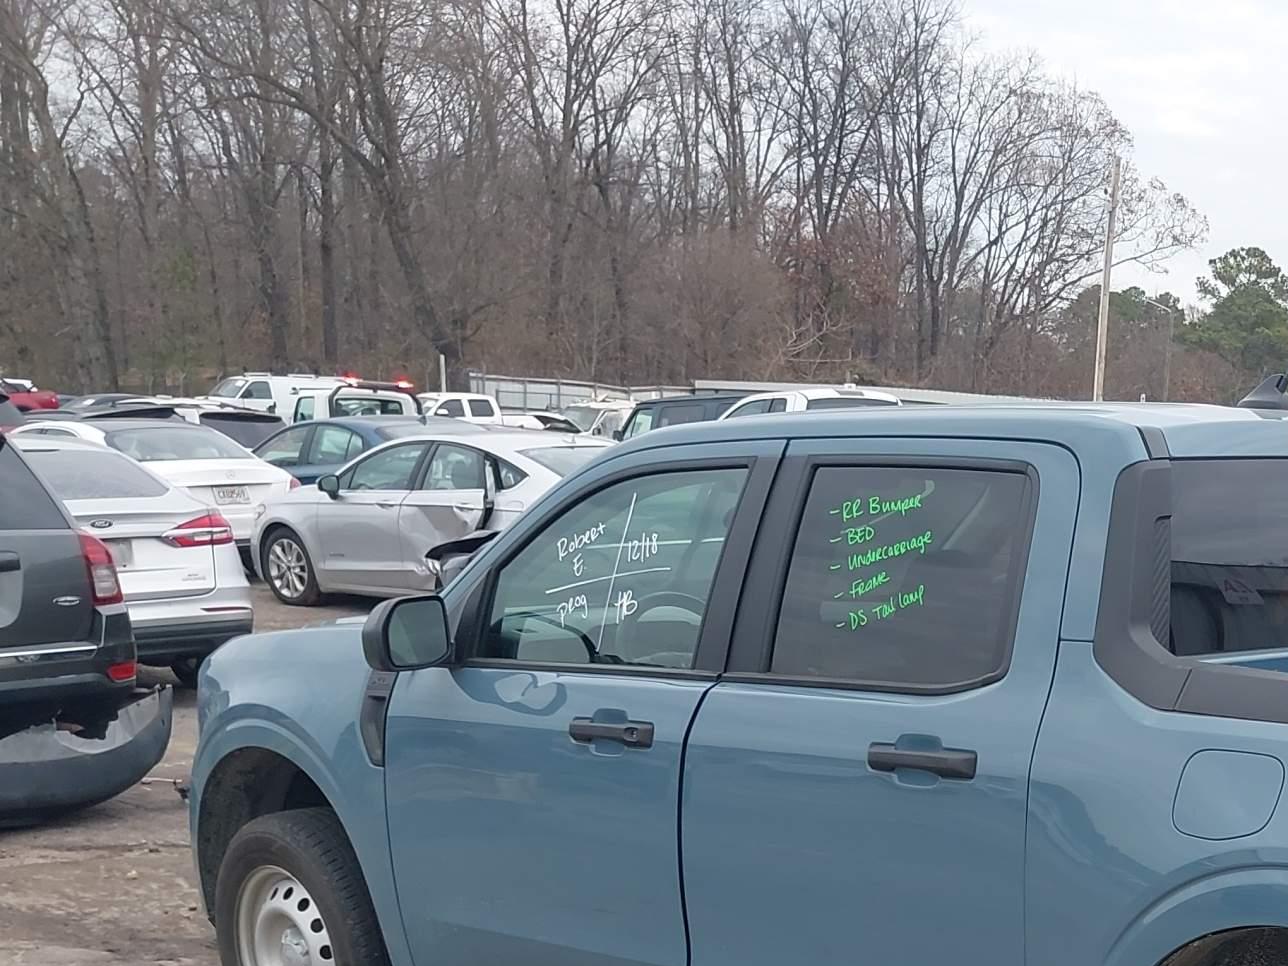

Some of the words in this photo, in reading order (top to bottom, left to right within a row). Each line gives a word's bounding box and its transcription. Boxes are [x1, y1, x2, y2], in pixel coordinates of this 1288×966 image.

[842, 498, 865, 522] RR
[627, 532, 659, 563] 12/18
[847, 527, 875, 545] BED
[848, 571, 891, 599] Frame
[848, 608, 868, 631] DS
